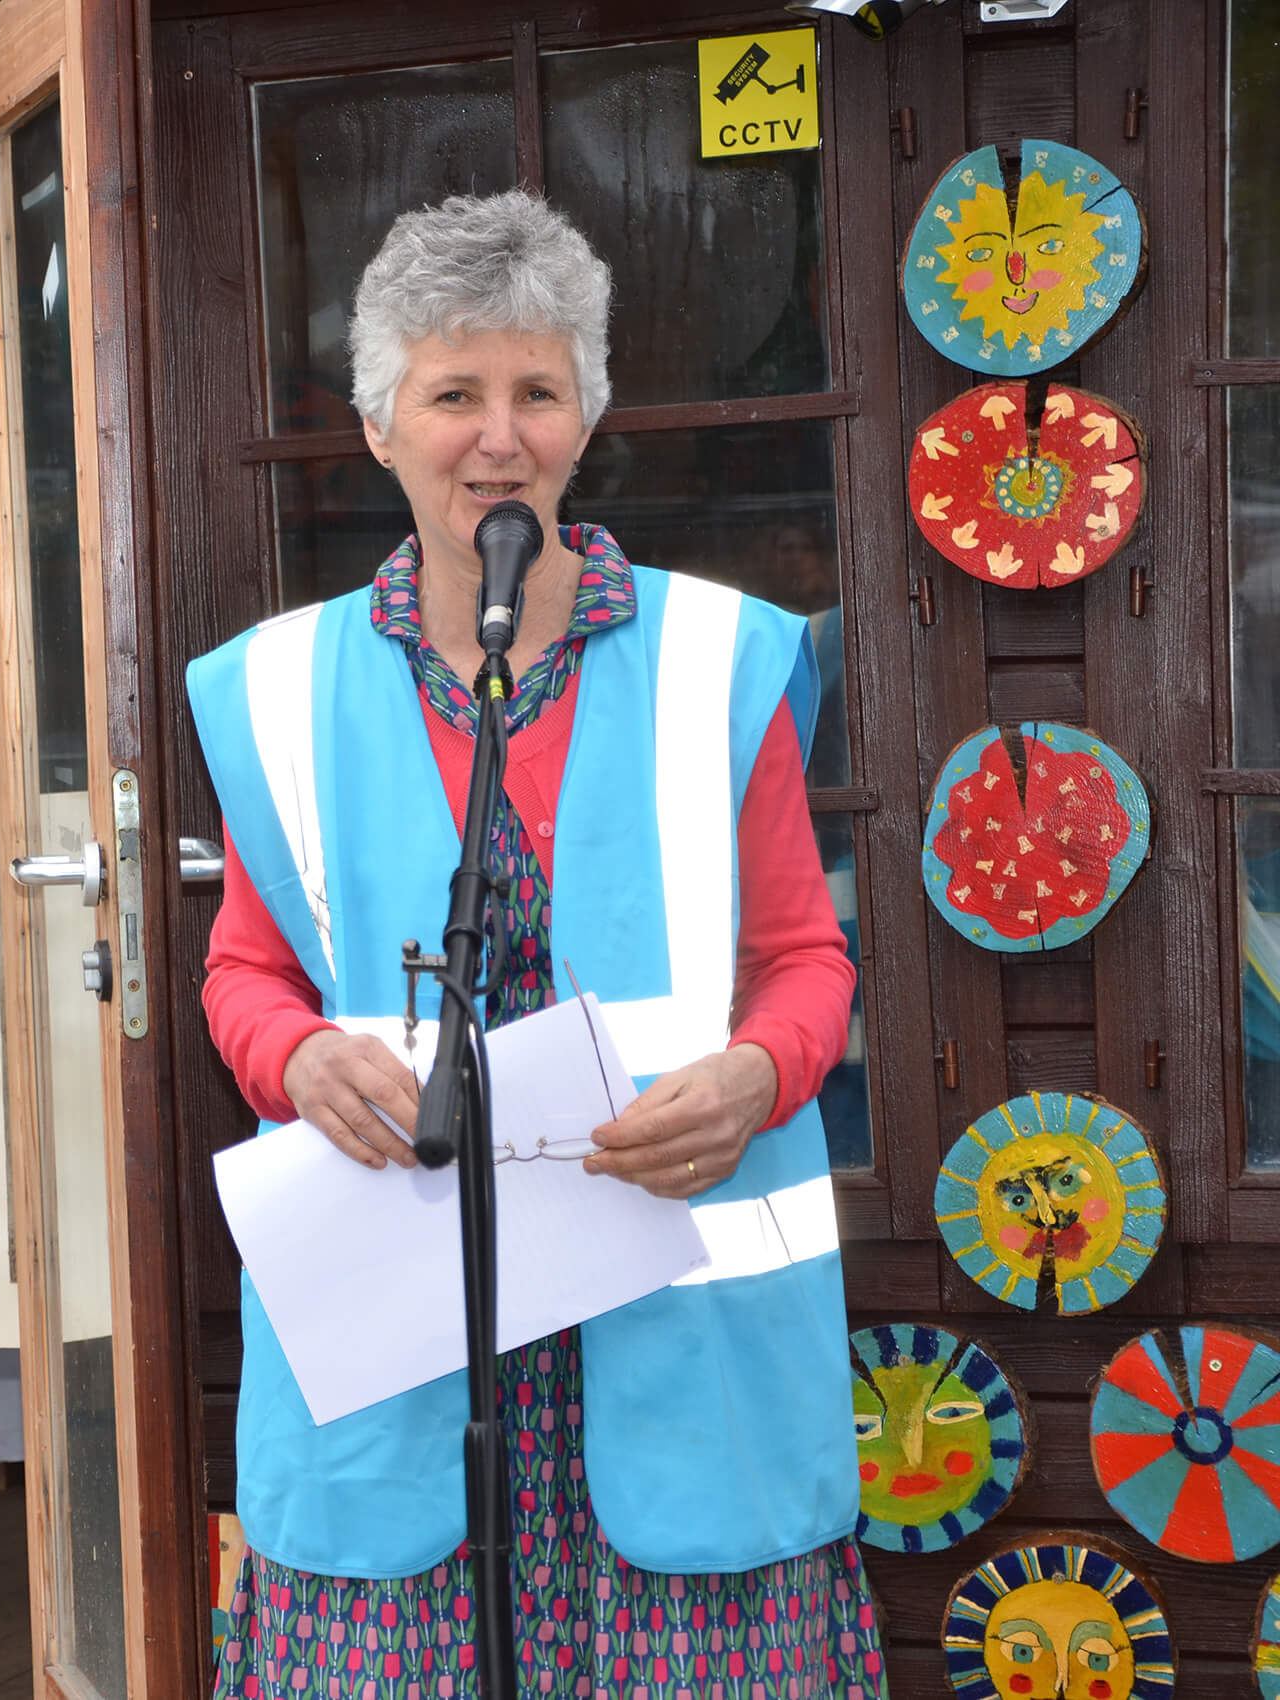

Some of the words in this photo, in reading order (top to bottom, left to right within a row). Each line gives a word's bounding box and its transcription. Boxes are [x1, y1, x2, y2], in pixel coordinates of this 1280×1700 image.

[727, 52, 755, 86] SECURITY
[734, 61, 758, 88] SYSTEM
[719, 118, 802, 147] CCTV
